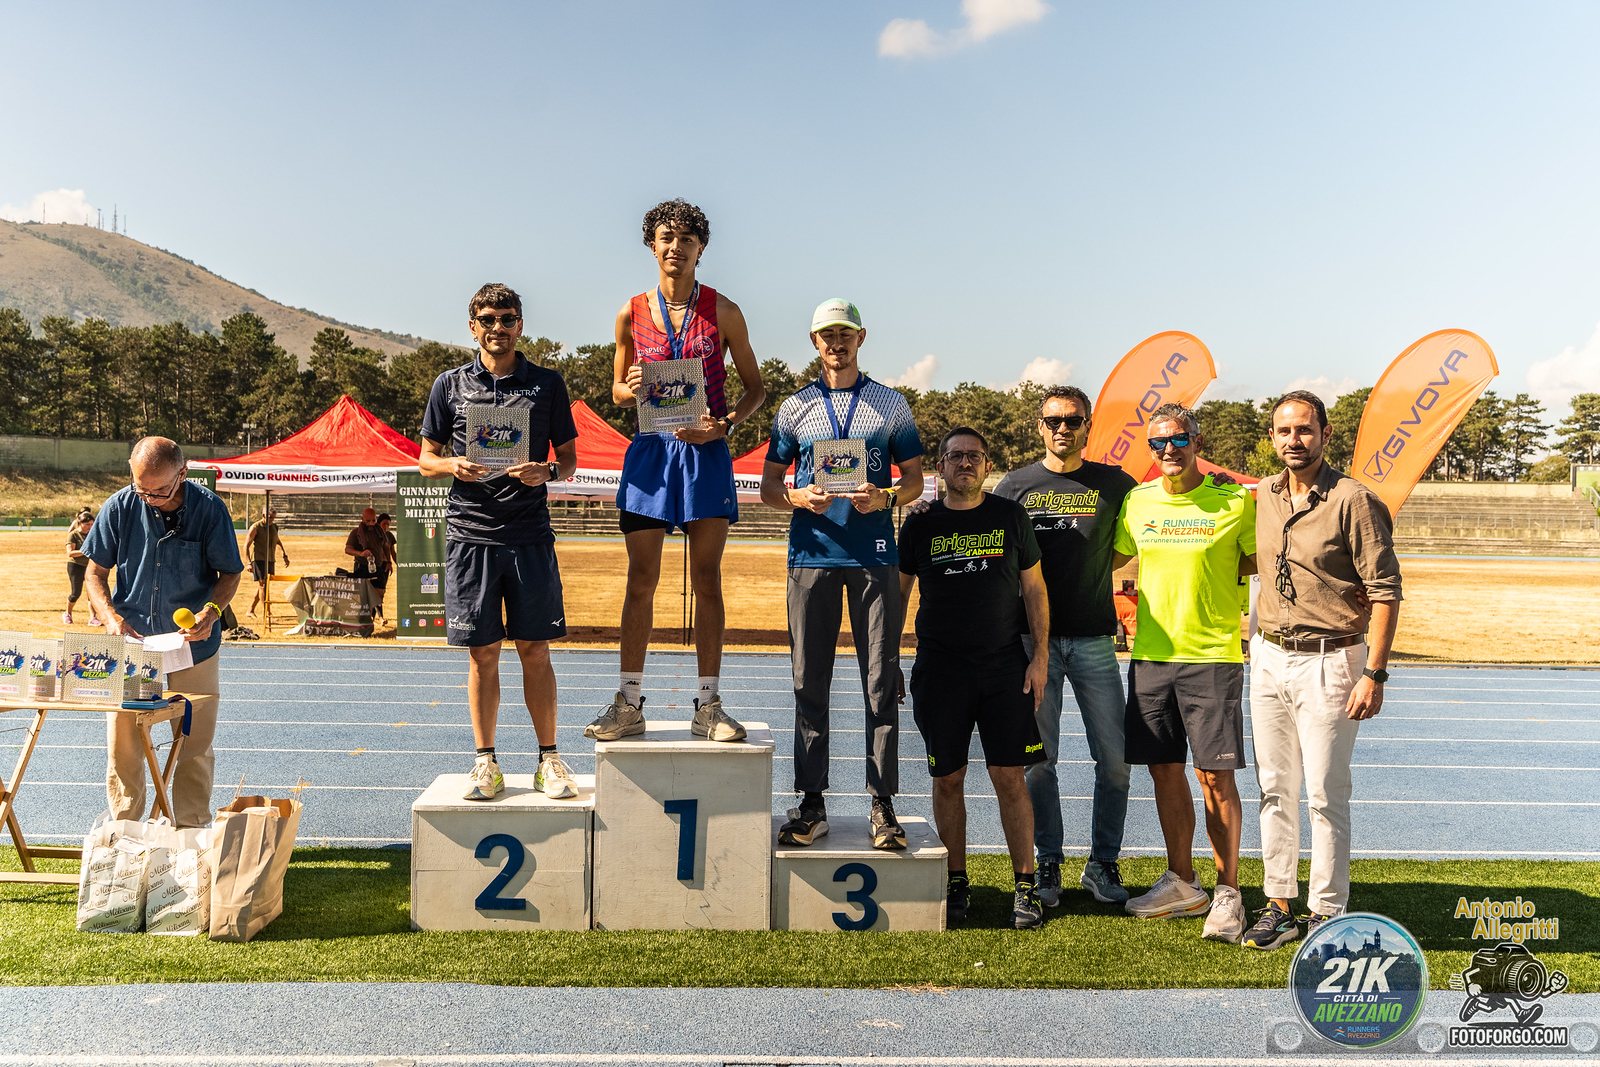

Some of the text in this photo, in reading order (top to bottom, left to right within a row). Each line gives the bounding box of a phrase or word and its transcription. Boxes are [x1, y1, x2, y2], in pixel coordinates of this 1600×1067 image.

[663, 384, 686, 398] 21K
[1110, 352, 1189, 461] GIVOVA
[1382, 349, 1468, 459] GIVOVA
[490, 430, 512, 440] 21K
[834, 458, 853, 467] 21K
[225, 471, 377, 483] OVIDIO RUNNING SULMONA
[575, 474, 622, 485] SULMON
[735, 480, 760, 489] OVID
[404, 498, 449, 507] DINAMIC
[1024, 490, 1100, 510] Briganti
[1058, 506, 1096, 514] d'Abruzzo
[1163, 519, 1216, 528] RUNNERS
[1161, 527, 1215, 536] AVEZZANO
[931, 529, 1005, 555] Briganti
[965, 548, 1004, 557] d'Abruzzo
[30, 659, 45, 670] 21K
[87, 659, 108, 670] 21K
[82, 671, 111, 679] AVEZZANO
[141, 668, 151, 677] 1K
[664, 799, 698, 881] 1
[474, 833, 527, 911] 2
[831, 862, 878, 930] 3
[105, 905, 136, 918] Molisana
[147, 900, 178, 918] Molisana
